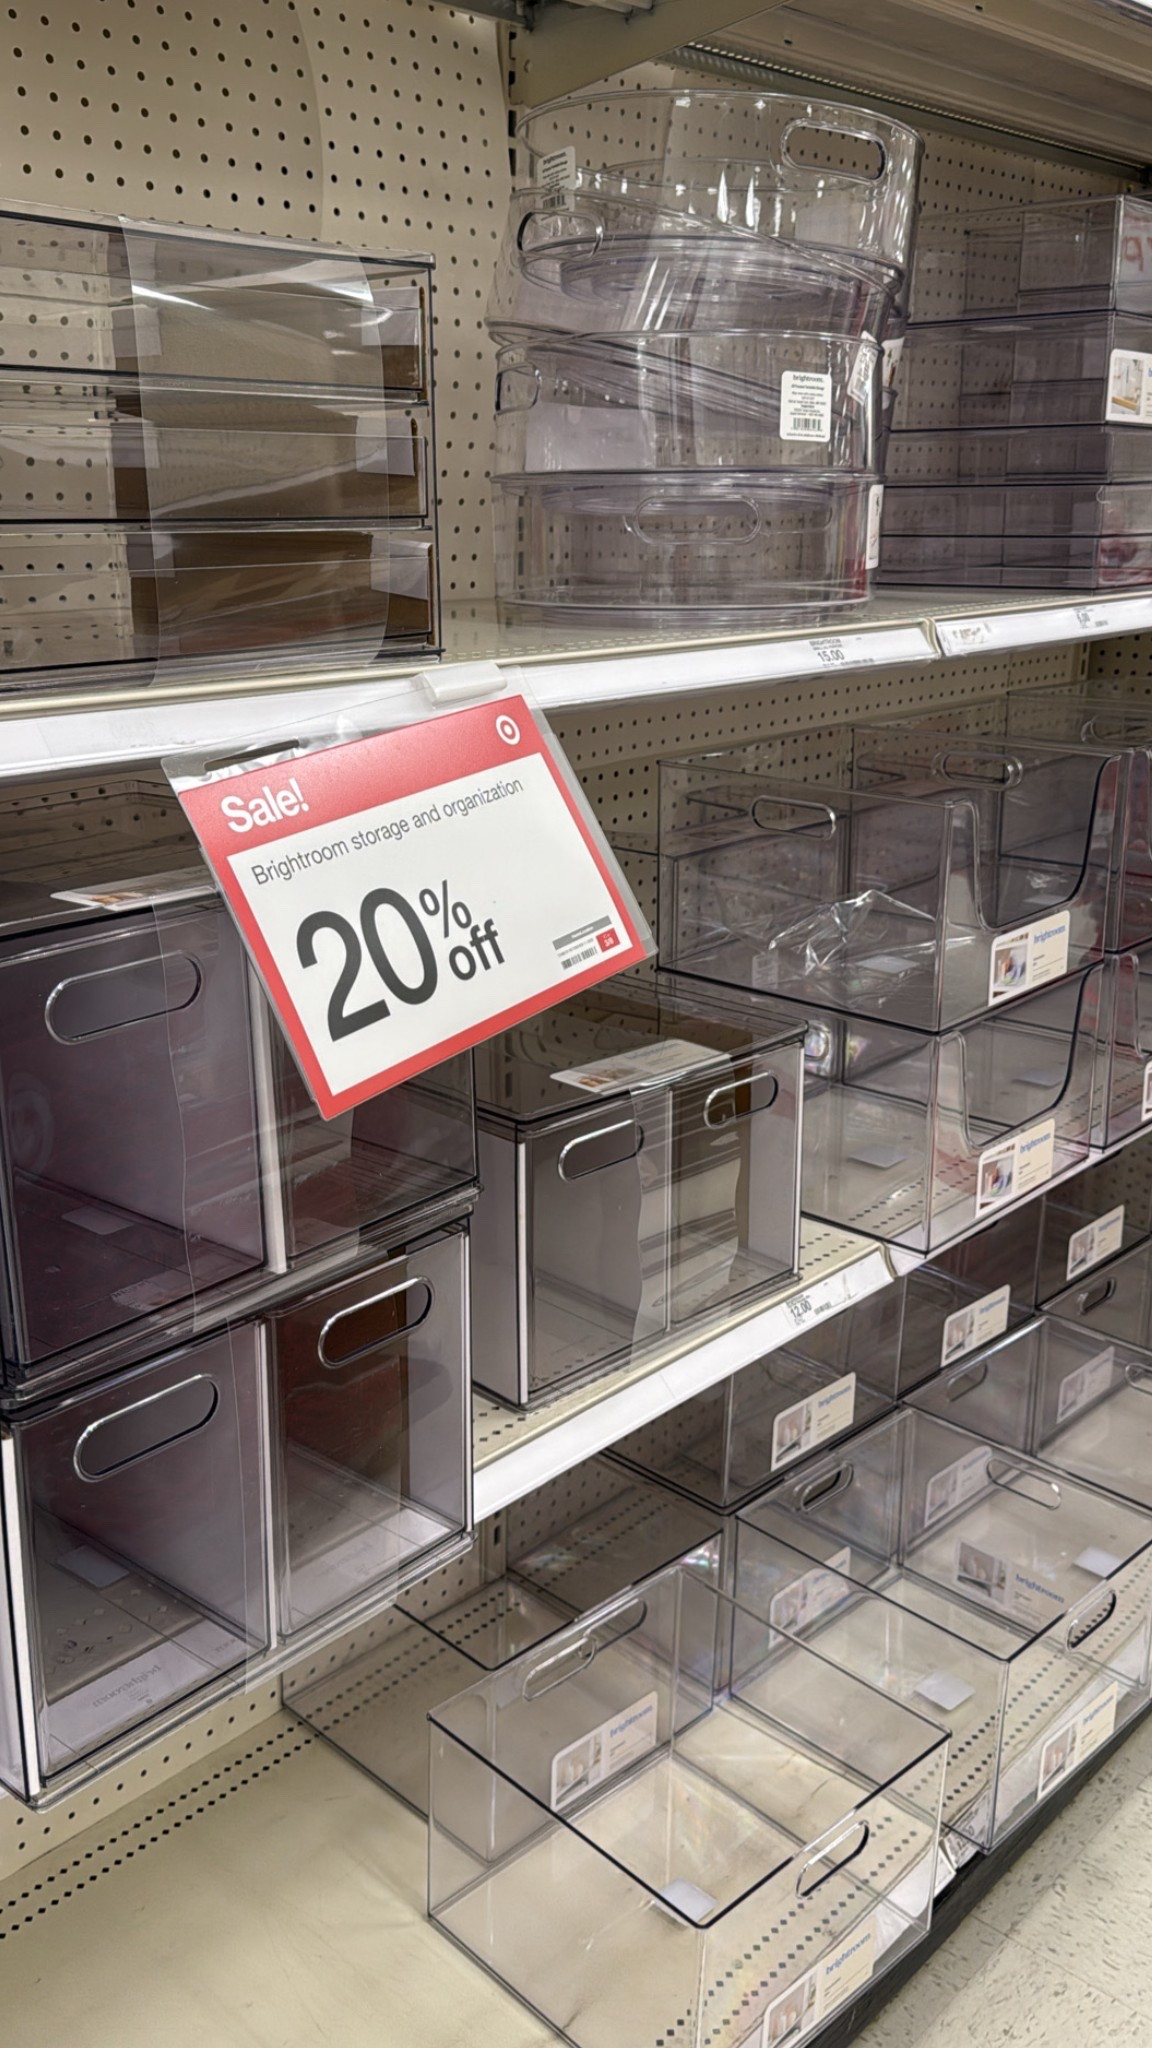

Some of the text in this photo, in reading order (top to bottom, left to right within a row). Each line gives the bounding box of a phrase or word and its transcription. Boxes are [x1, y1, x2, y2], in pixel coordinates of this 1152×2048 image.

[817, 649, 845, 662] 15.00
[221, 777, 310, 832] Sale!
[251, 777, 524, 886] Brightroom storage and organization
[448, 918, 505, 981] off
[790, 1301, 812, 1319] 12.00
[1016, 1573, 1065, 1605] brightroom
